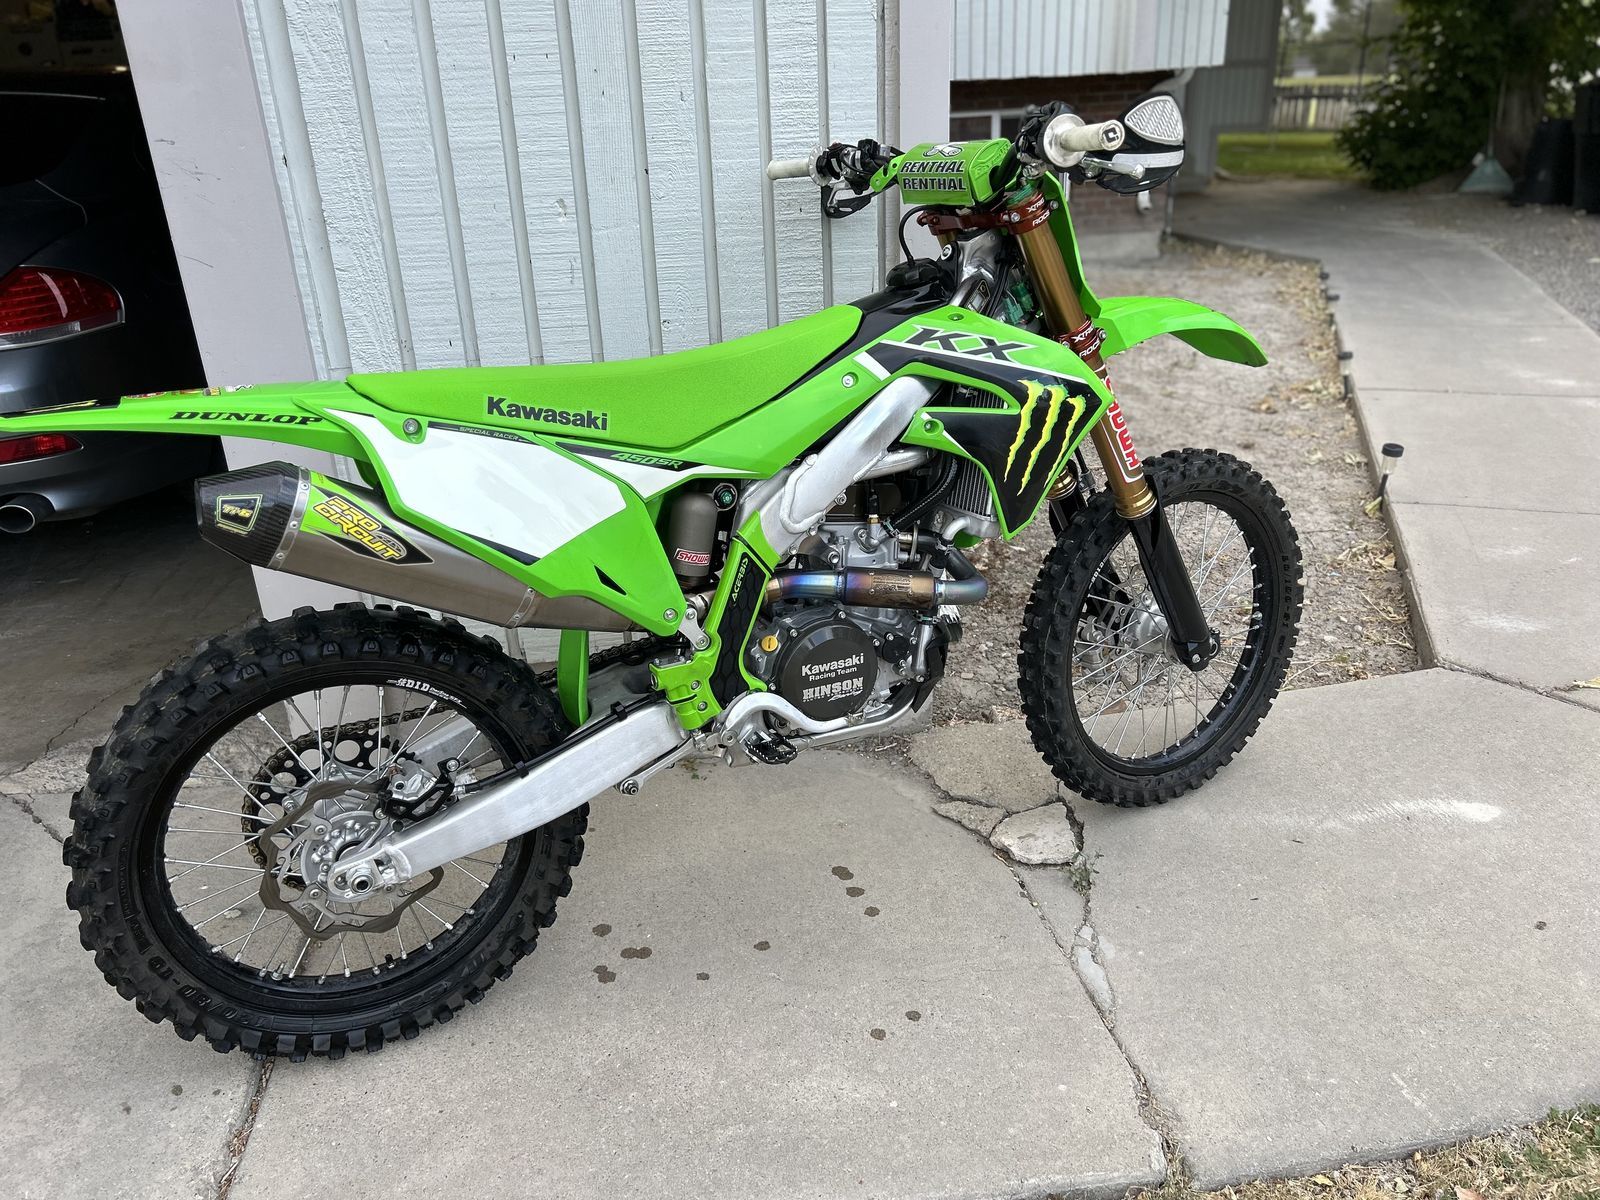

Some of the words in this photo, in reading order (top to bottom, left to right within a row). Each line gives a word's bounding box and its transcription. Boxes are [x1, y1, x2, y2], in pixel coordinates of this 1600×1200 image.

[900, 160, 965, 173] RENTHAL
[902, 177, 967, 191] RENTHAL
[904, 325, 1038, 365] KX
[169, 411, 323, 425] DUNLOP
[486, 396, 608, 431] Kawasaki
[459, 426, 491, 436] SPECIAL
[493, 431, 519, 441] RACER
[610, 452, 684, 469] 450SR
[325, 496, 382, 532] PRO
[313, 503, 402, 559] CIRCUIT
[801, 652, 864, 677] Kawasaki
[809, 671, 836, 682] Racing
[836, 666, 857, 675] Team
[803, 677, 864, 700] HINSON
